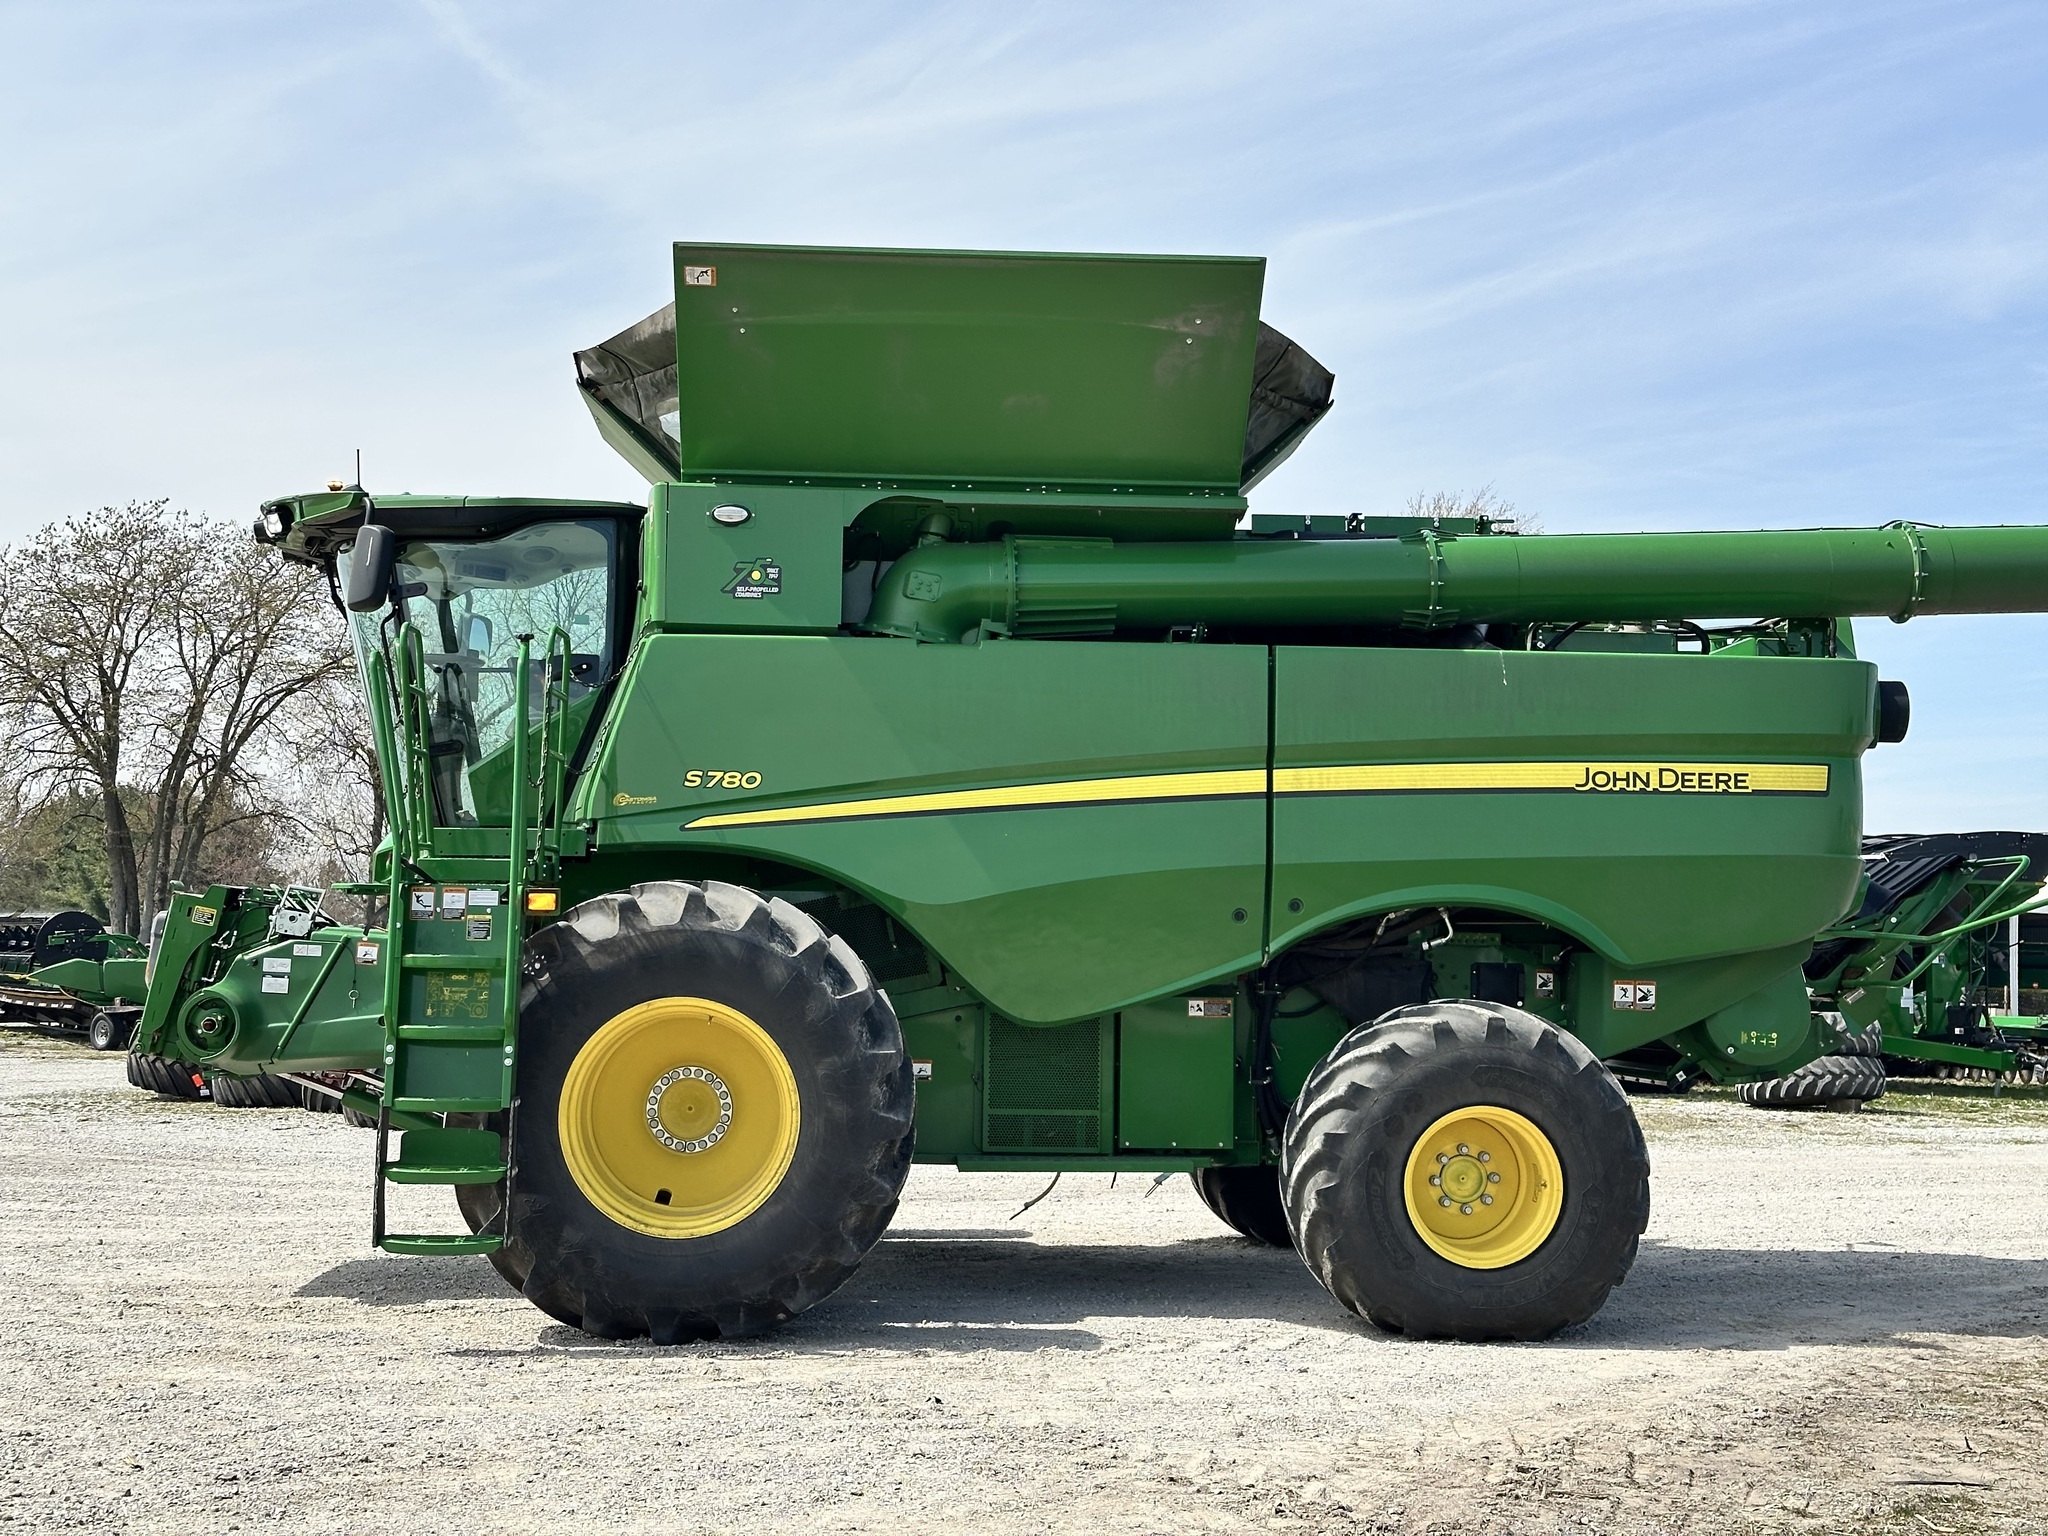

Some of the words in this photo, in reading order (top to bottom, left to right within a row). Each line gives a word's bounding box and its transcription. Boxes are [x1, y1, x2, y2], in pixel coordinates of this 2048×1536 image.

[683, 769, 763, 789] S780
[1574, 767, 1651, 789] JOHN
[1658, 767, 1750, 790] DEERE
